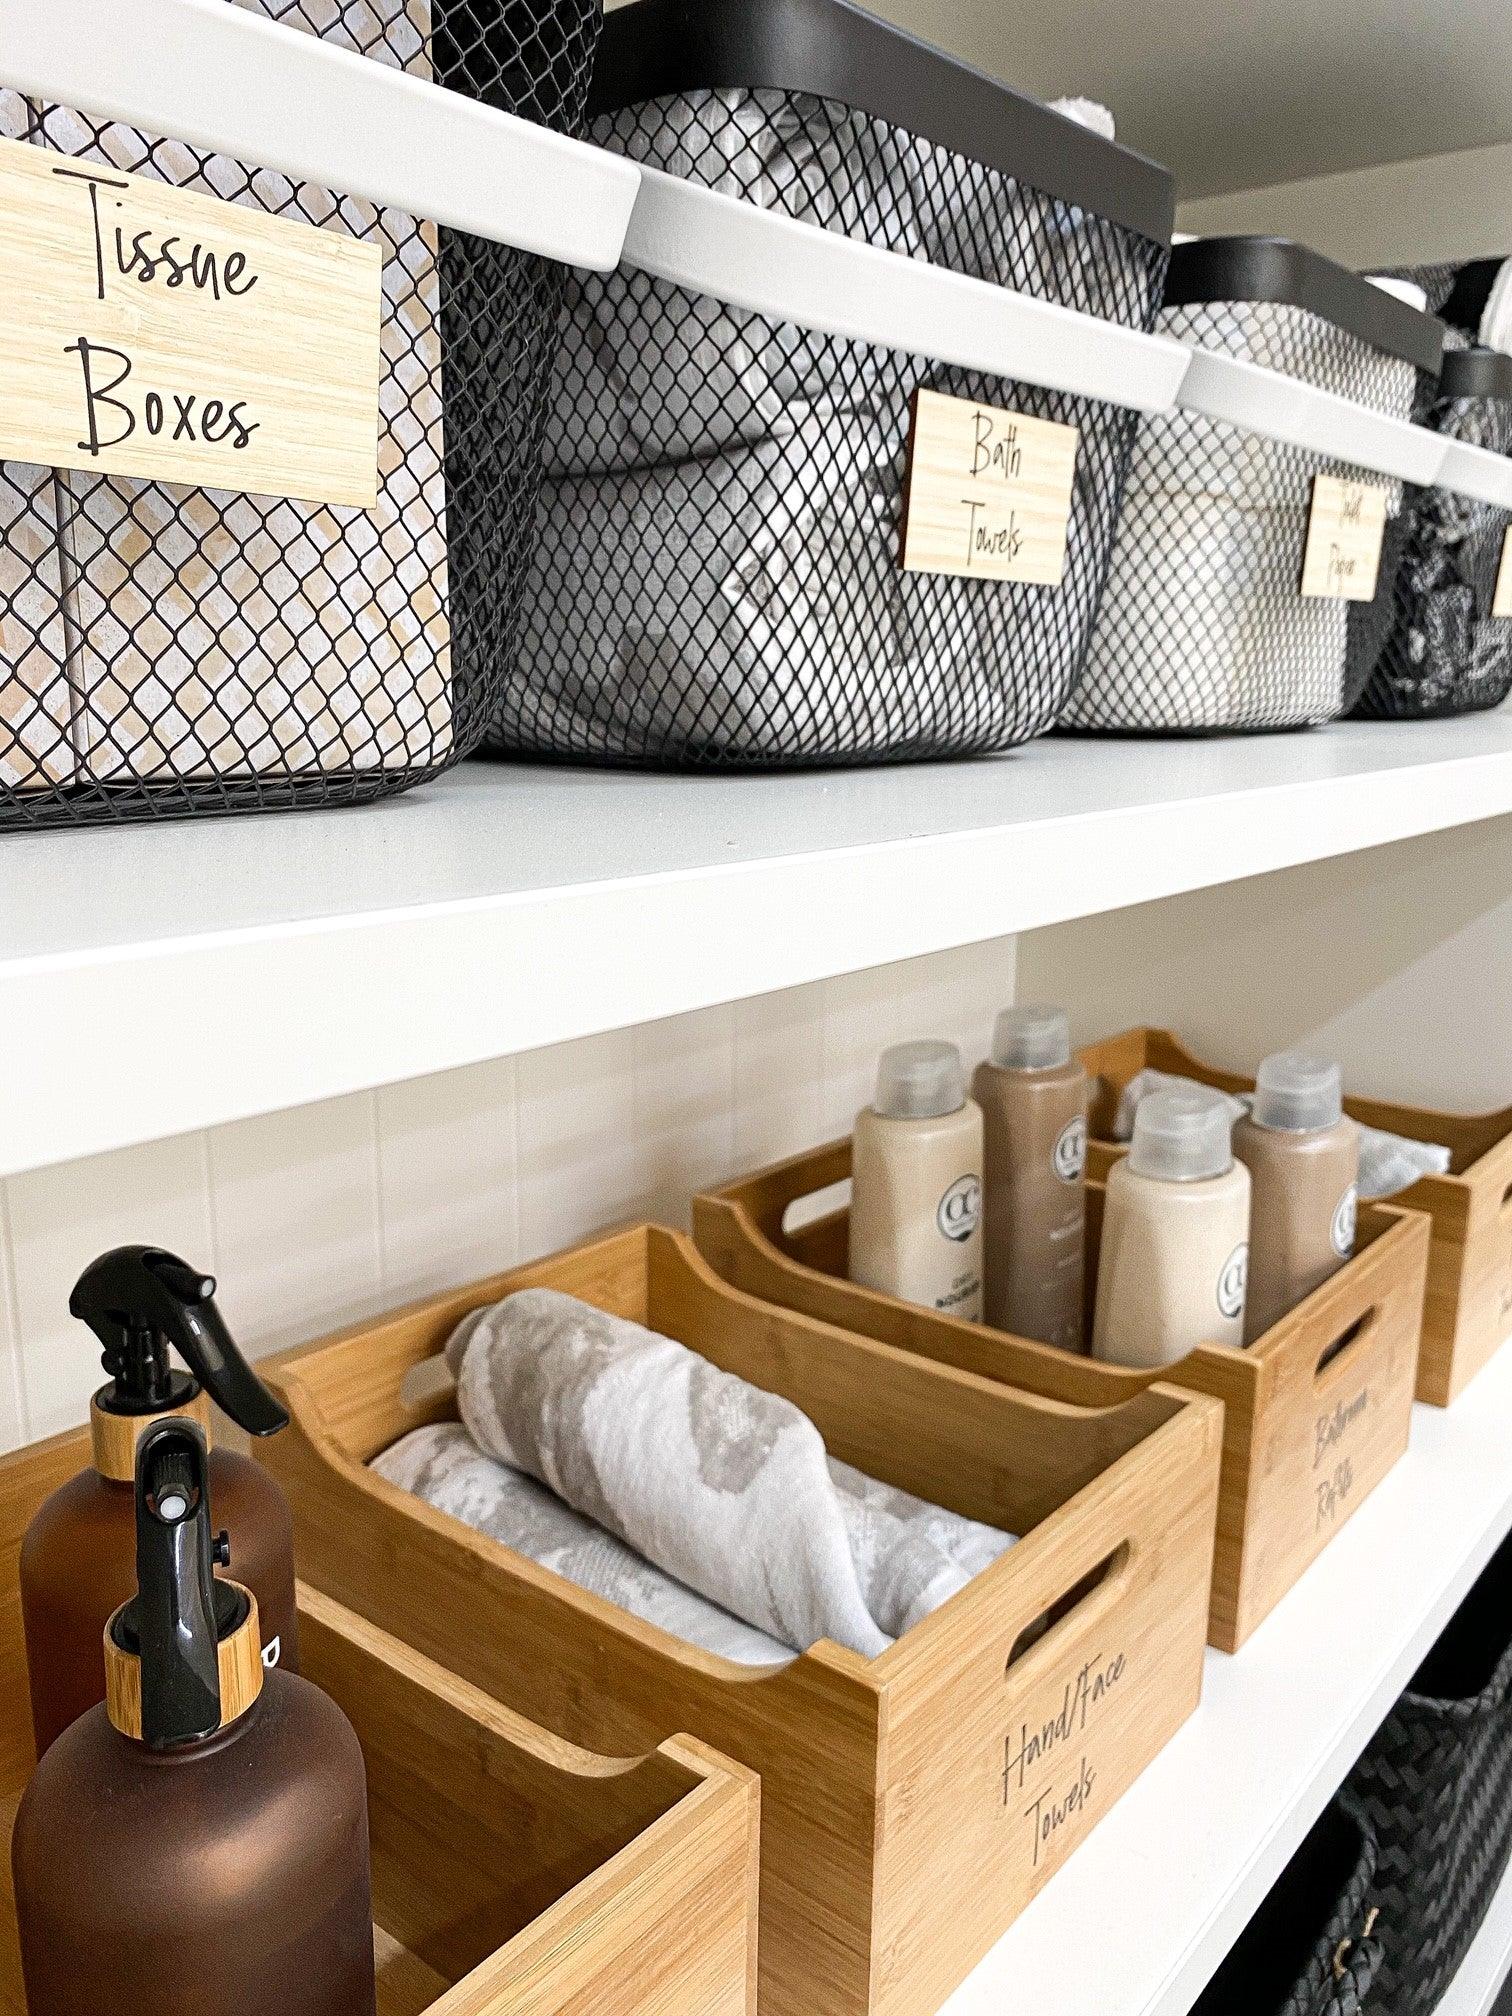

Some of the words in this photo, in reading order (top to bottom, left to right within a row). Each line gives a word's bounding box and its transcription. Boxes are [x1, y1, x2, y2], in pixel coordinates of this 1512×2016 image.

[52, 167, 258, 300] Tissue
[64, 336, 261, 456] Boxes
[969, 410, 1022, 479] Bath
[960, 499, 1024, 568] Towels
[1001, 1651, 1127, 1807] Hand/Face
[1023, 1756, 1098, 1867] Towels
